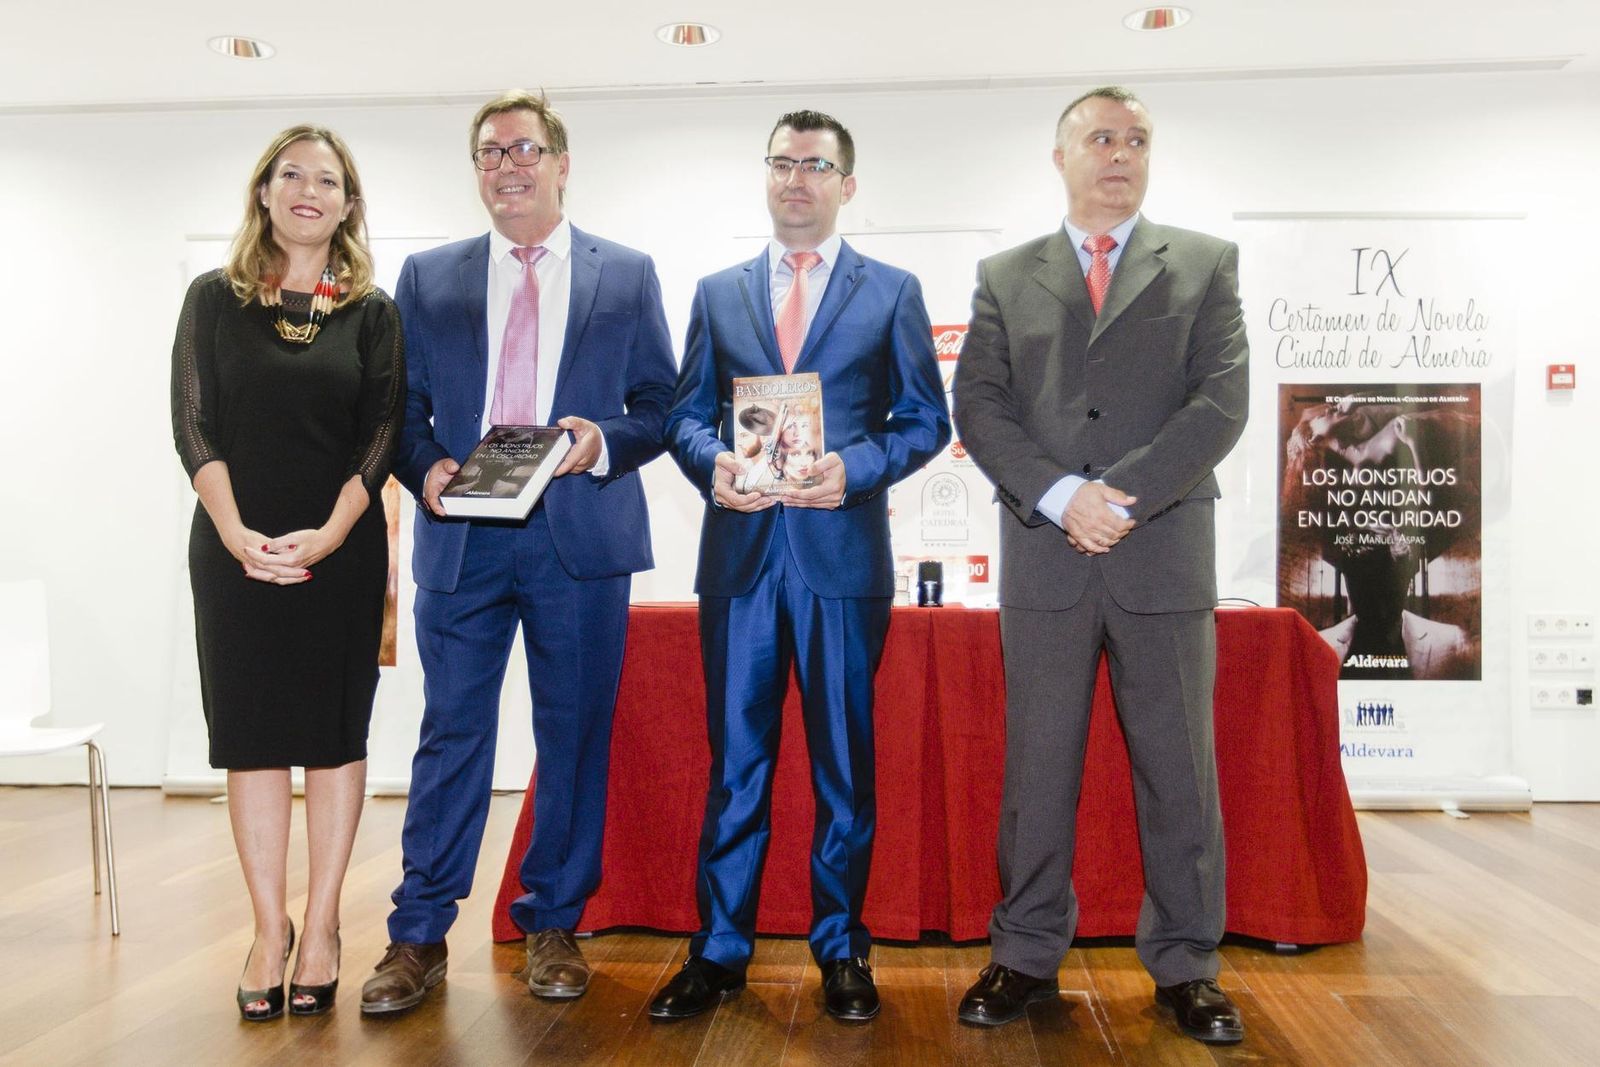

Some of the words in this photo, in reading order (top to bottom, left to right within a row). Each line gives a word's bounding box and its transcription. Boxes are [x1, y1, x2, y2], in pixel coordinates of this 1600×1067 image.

[1347, 247, 1410, 297] IX
[1268, 298, 1370, 332] Certamen
[1376, 298, 1400, 332] de
[1406, 298, 1490, 332] Novela
[1275, 335, 1351, 368] Ciudad
[1358, 336, 1382, 368] de
[1390, 335, 1492, 368] Almería
[735, 383, 818, 397] BANDOLEROS
[1302, 468, 1337, 485] LOS
[1342, 468, 1456, 485] MONSTRUOS
[1327, 490, 1355, 506] NO
[1360, 490, 1431, 506] ANIDAN
[1298, 510, 1321, 527] EN
[1327, 510, 1349, 527] LA
[1354, 510, 1461, 527] OSCURIDAD
[1358, 533, 1395, 545] MANUEL
[1398, 533, 1426, 545] ASPAS
[1344, 654, 1409, 668] Aldevara
